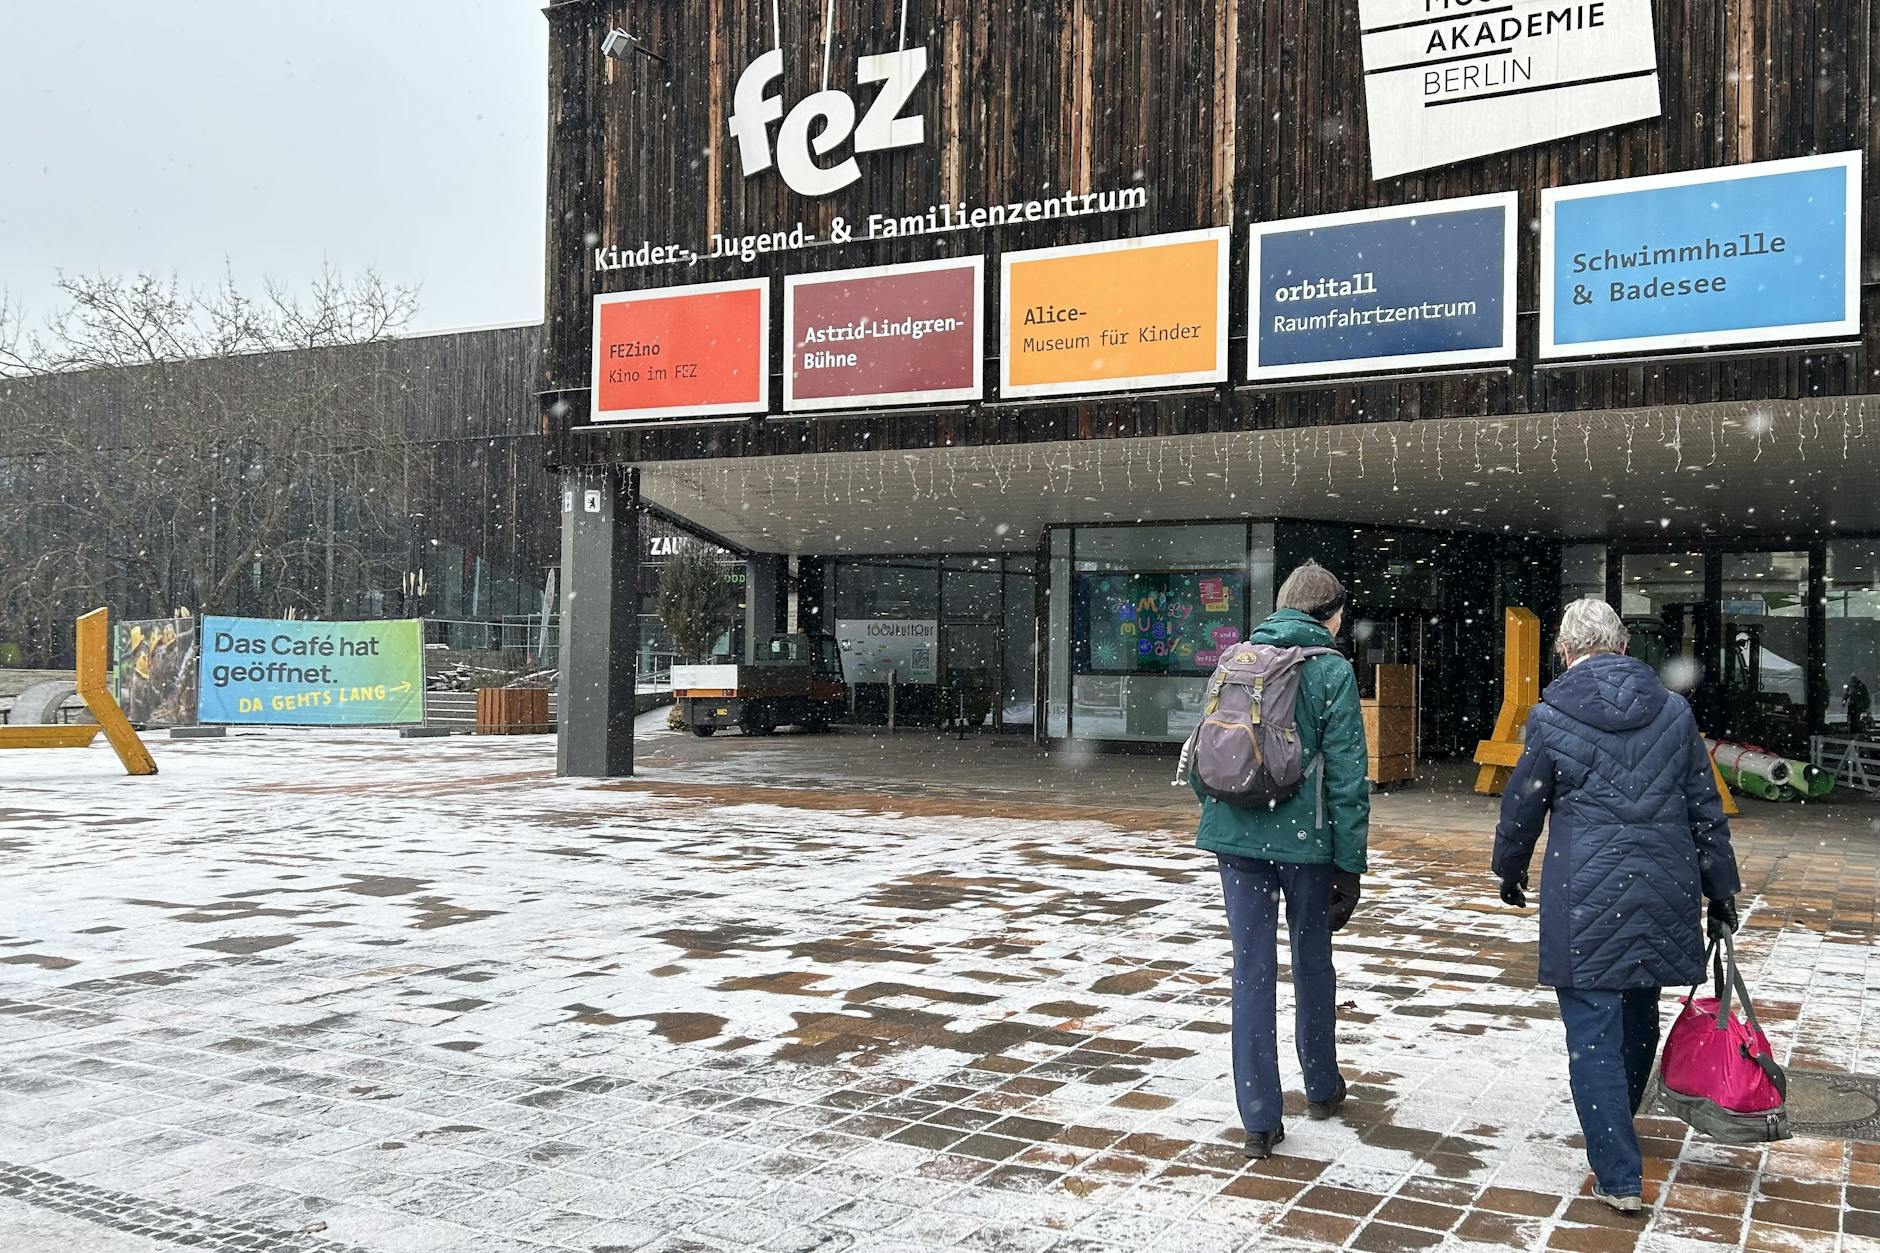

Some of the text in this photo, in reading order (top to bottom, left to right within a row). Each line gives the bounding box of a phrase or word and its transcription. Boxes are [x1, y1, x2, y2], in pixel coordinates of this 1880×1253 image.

[1426, 2, 1604, 54] AKADEMIE
[1424, 56, 1532, 95] BERLIN
[594, 186, 1147, 271] Kinder-, Jugend- & Familienzentrum
[1573, 232, 1786, 274] Schwimmhalle
[1274, 272, 1378, 302] orbitall
[1572, 275, 1727, 306] & Badesee
[804, 316, 965, 344] Astrid-Lindgren-
[1023, 304, 1088, 326] Alice-
[1273, 300, 1477, 333] Raumfahrtzentrum
[609, 341, 661, 359] FEZino
[1023, 323, 1202, 353] Museum für Kinder
[609, 363, 698, 384] Kino im FEZ
[804, 350, 858, 370] Bühne
[214, 632, 380, 657] Das Café hat
[212, 661, 338, 688] geöffnet.
[238, 684, 386, 714] DA GEHTS LANG
